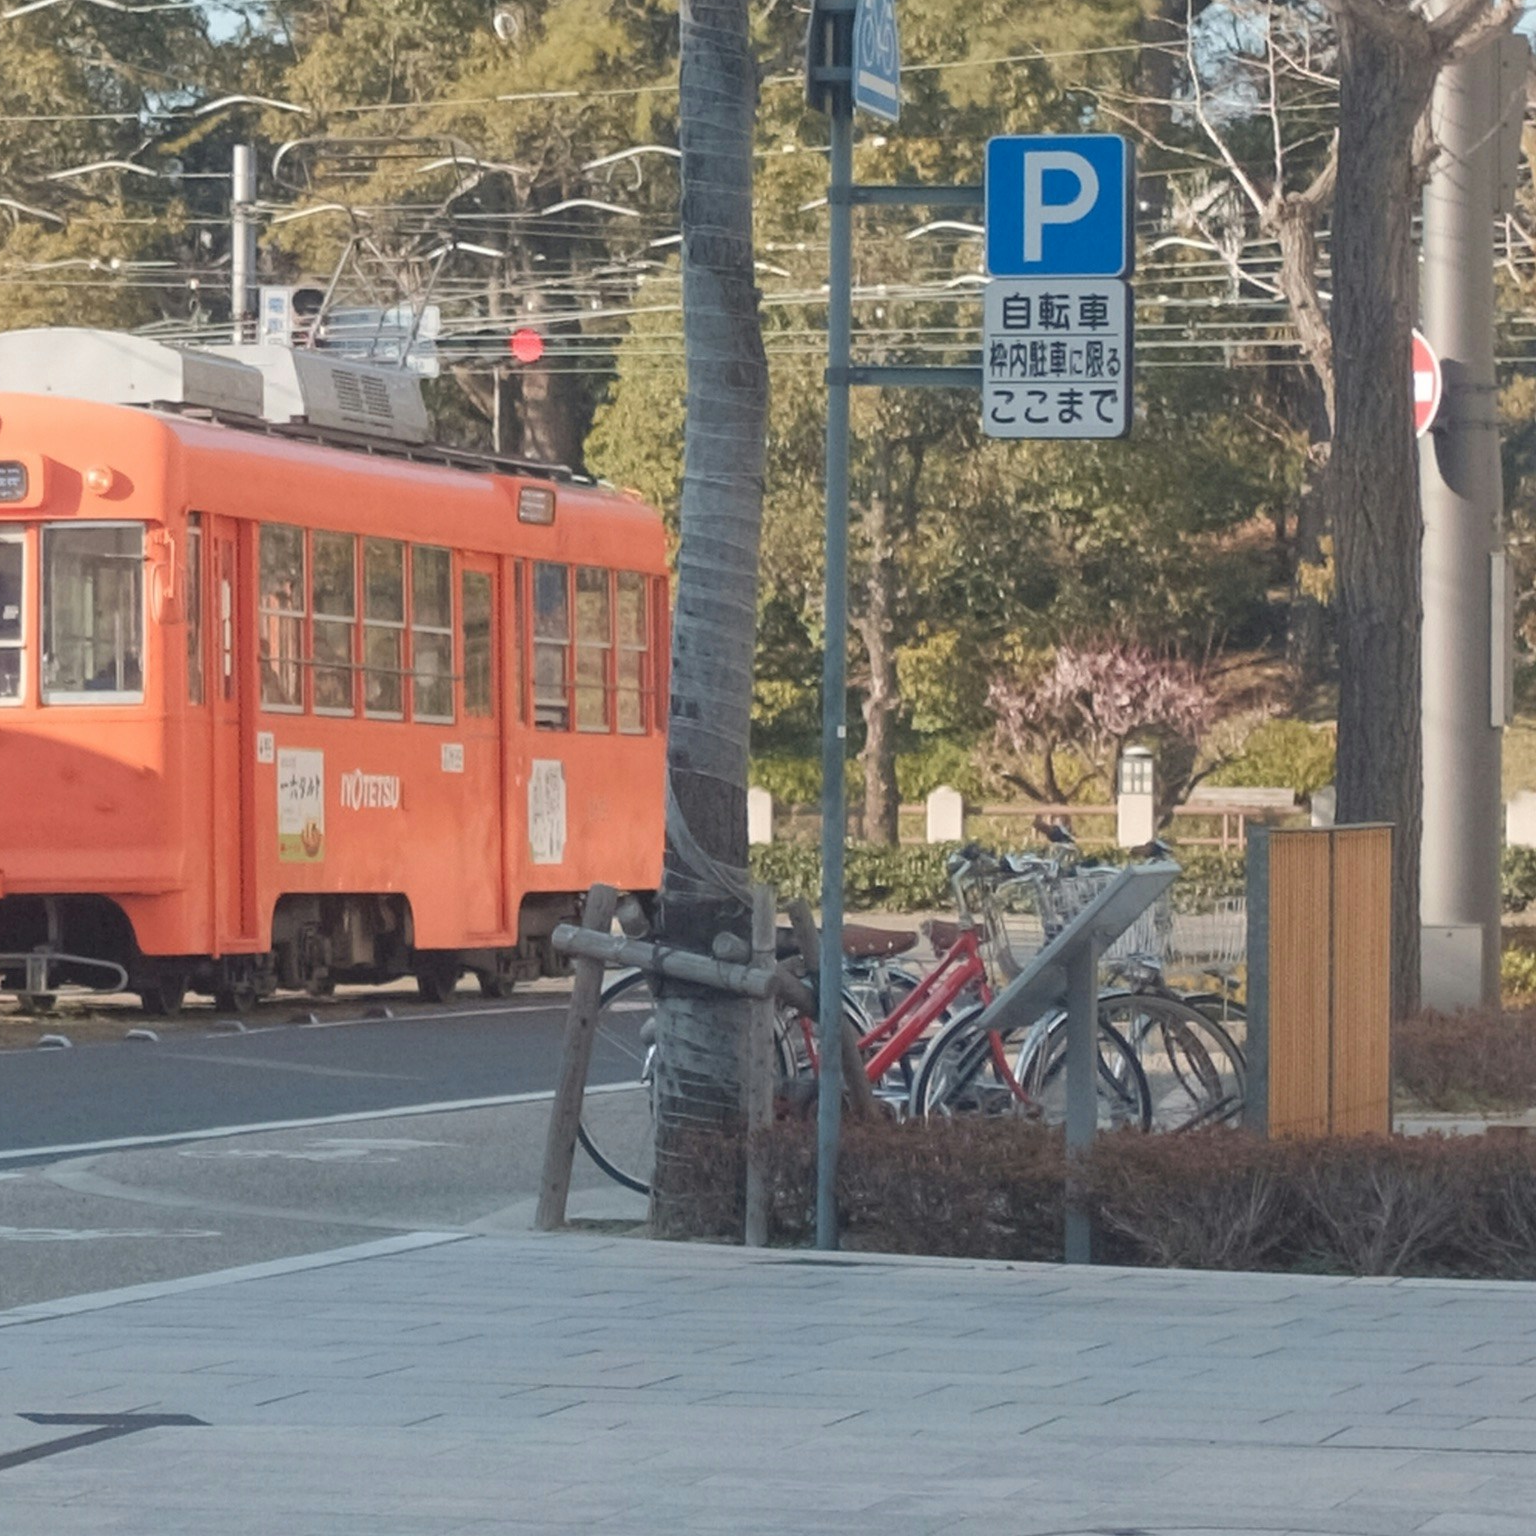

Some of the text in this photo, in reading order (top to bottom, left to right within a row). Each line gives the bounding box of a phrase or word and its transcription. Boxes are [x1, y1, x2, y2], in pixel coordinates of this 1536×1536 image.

[1023, 151, 1099, 262] P
[1003, 292, 1109, 331] 自転車
[990, 340, 1121, 378] 枠内駐車に限る
[991, 388, 1118, 424] ここまで
[340, 768, 400, 811] IYOTETSU
